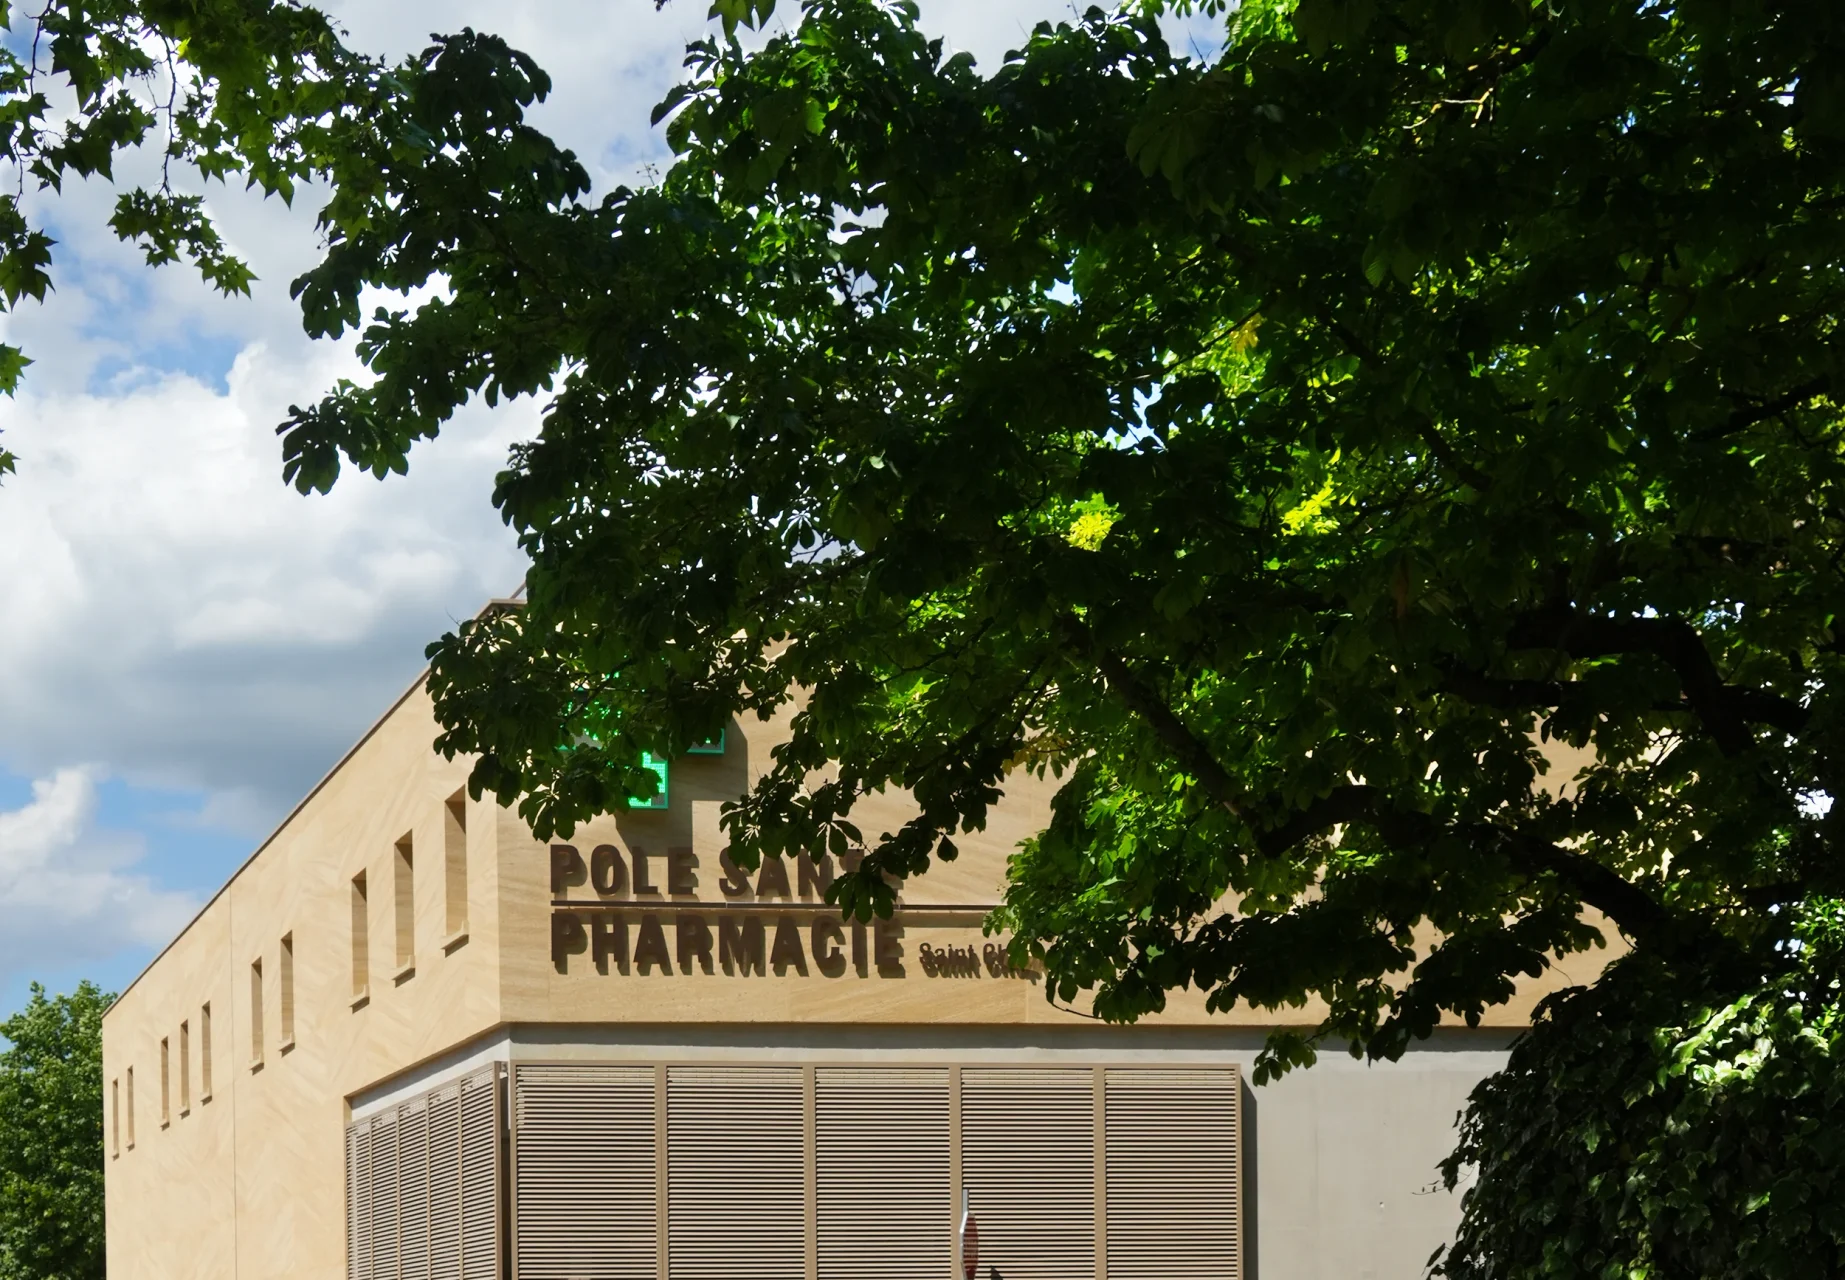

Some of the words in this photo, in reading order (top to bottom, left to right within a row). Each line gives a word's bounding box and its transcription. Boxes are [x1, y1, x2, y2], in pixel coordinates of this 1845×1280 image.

[551, 844, 697, 896] POLE
[551, 912, 902, 969] PHARMACIE
[919, 942, 978, 971] Saint
